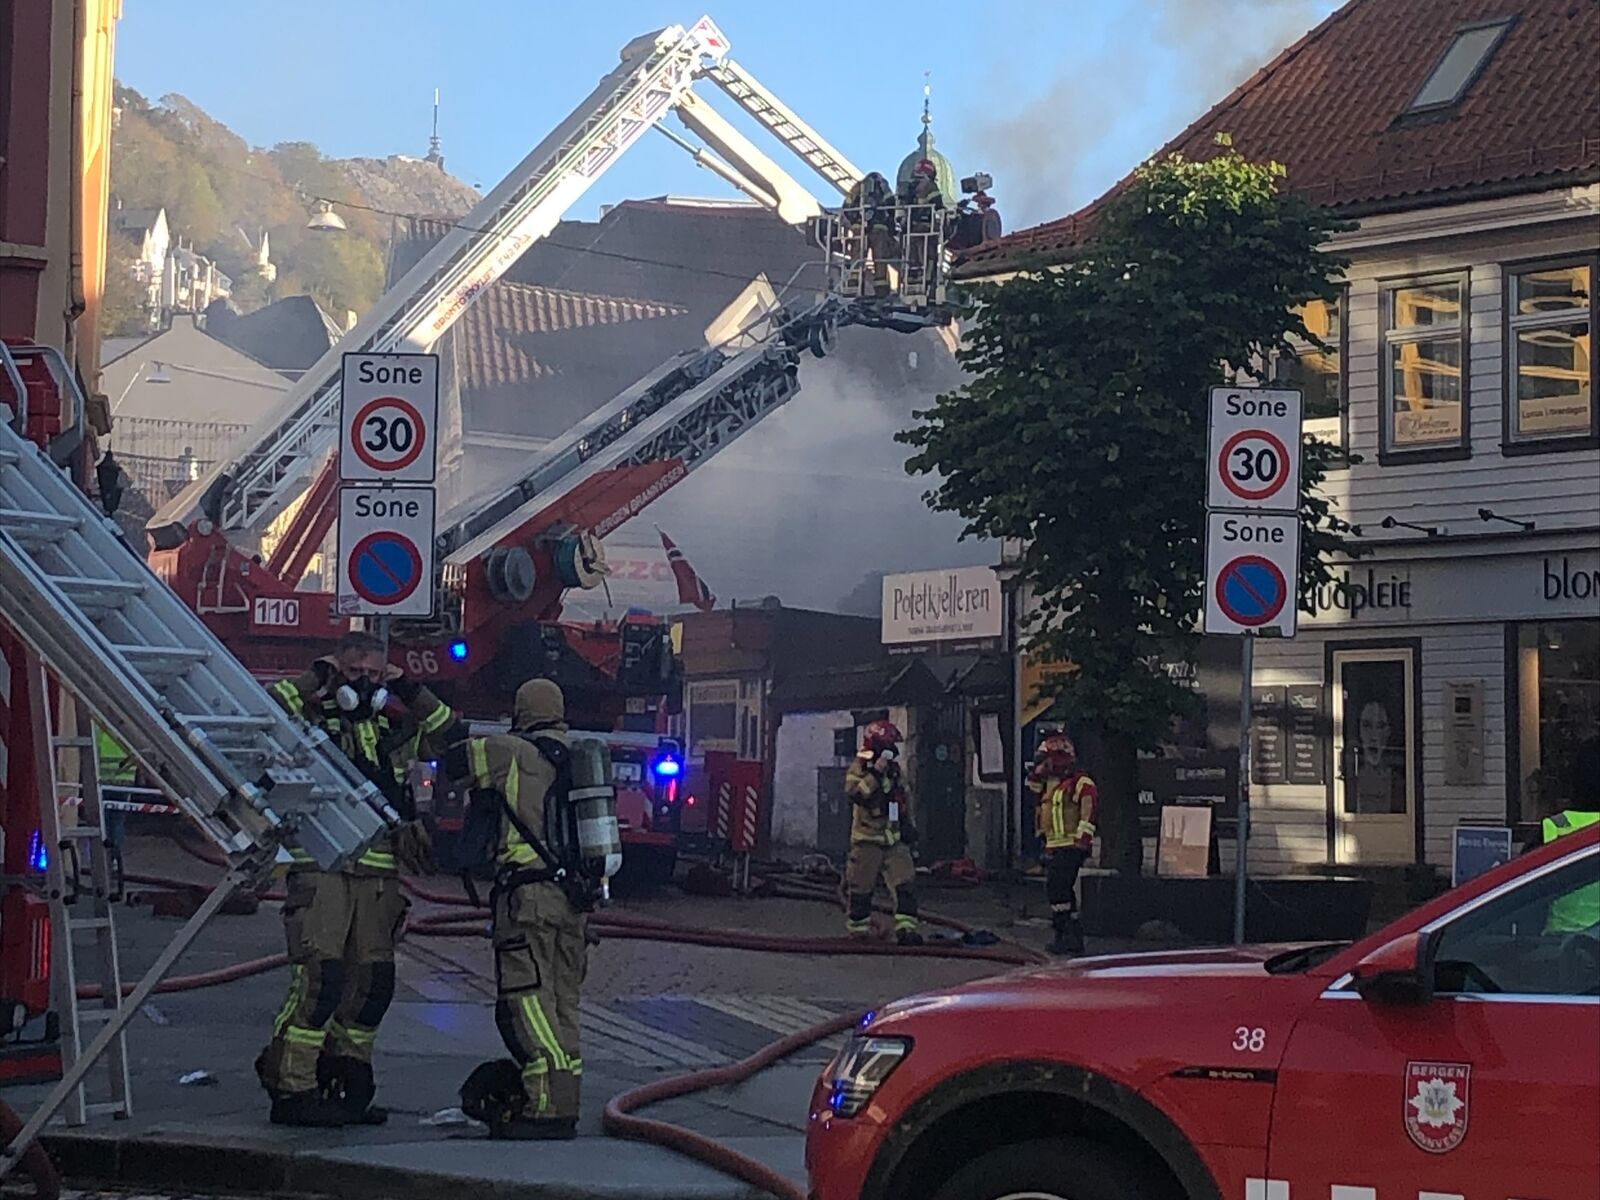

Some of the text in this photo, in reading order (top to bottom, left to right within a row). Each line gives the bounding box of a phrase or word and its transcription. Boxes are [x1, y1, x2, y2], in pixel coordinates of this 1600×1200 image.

[358, 361, 423, 384] Sone
[1225, 394, 1288, 417] Sone
[365, 416, 413, 452] 30
[1231, 447, 1278, 482] 30
[355, 495, 420, 518] Sone
[1222, 520, 1285, 543] Sone
[893, 575, 990, 621] Potetkjelleren
[257, 599, 298, 624] 110
[406, 650, 439, 674] 66
[1231, 1026, 1266, 1052] 38
[1411, 1065, 1466, 1078] BERGEN
